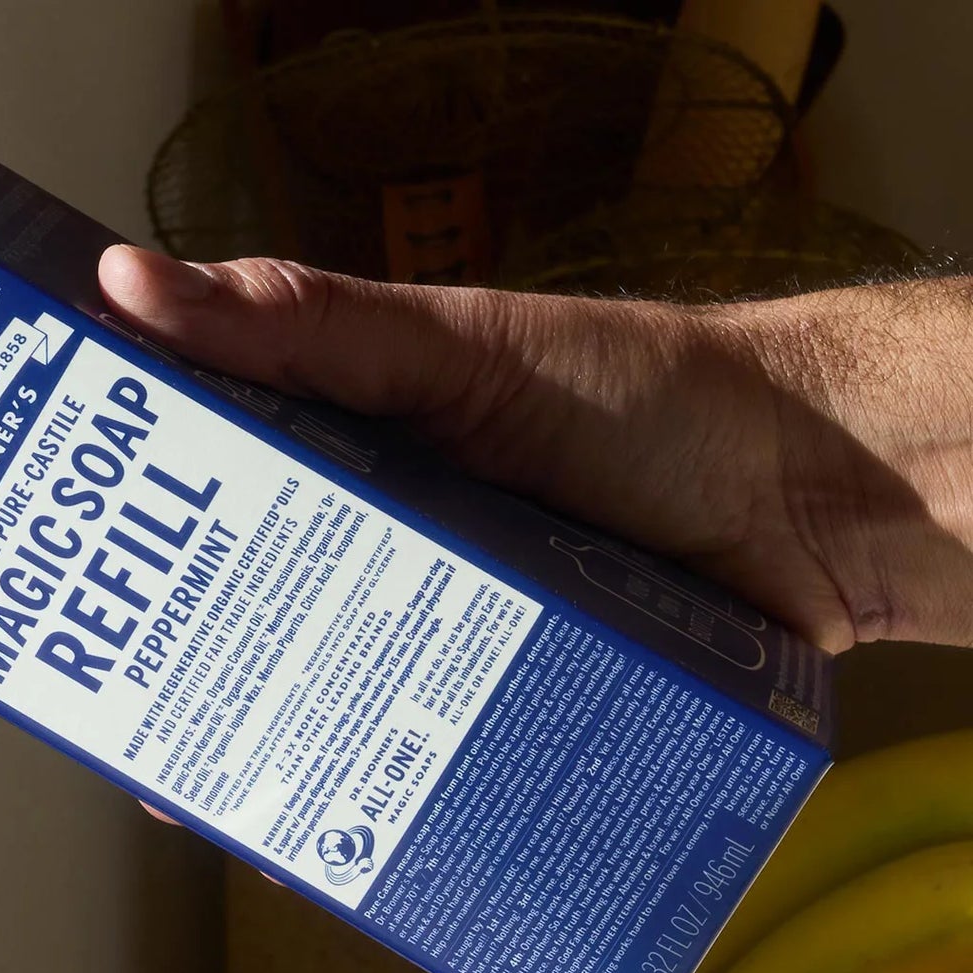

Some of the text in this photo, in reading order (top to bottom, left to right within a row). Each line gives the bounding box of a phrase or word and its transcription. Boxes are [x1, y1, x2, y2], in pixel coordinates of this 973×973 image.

[51, 376, 159, 521] SOAP
[34, 463, 222, 694] REFILL
[122, 728, 149, 761] MADE
[140, 700, 166, 730] WITH
[157, 619, 214, 703] REGENERATIVE
[206, 569, 245, 621] ORGANIC
[275, 477, 300, 506] OILS
[123, 518, 238, 689] PEPPERMINT
[156, 517, 298, 744] AND CERTIFIED FAIR TRADE INGREDIENTS
[280, 609, 393, 784] THAN OTHER LEADING BRANDS
[294, 706, 319, 740] MORE
[316, 611, 376, 704] CONCENTRATED
[449, 688, 476, 726] ALL-ONE
[471, 674, 484, 688] OR
[480, 646, 502, 675] NONE!
[198, 771, 229, 811] Limonene
[348, 727, 398, 801] DR. BRONNER'S
[387, 751, 437, 824] MAGIC SOAPS
[396, 844, 417, 872] means
[413, 823, 431, 845] soap
[426, 799, 445, 824] made
[440, 778, 459, 800] from
[455, 754, 474, 780] plant
[470, 738, 484, 755] oils
[479, 703, 505, 738] without
[501, 662, 530, 704] synthetic
[655, 933, 692, 958] FL
[670, 903, 708, 936] OZ
